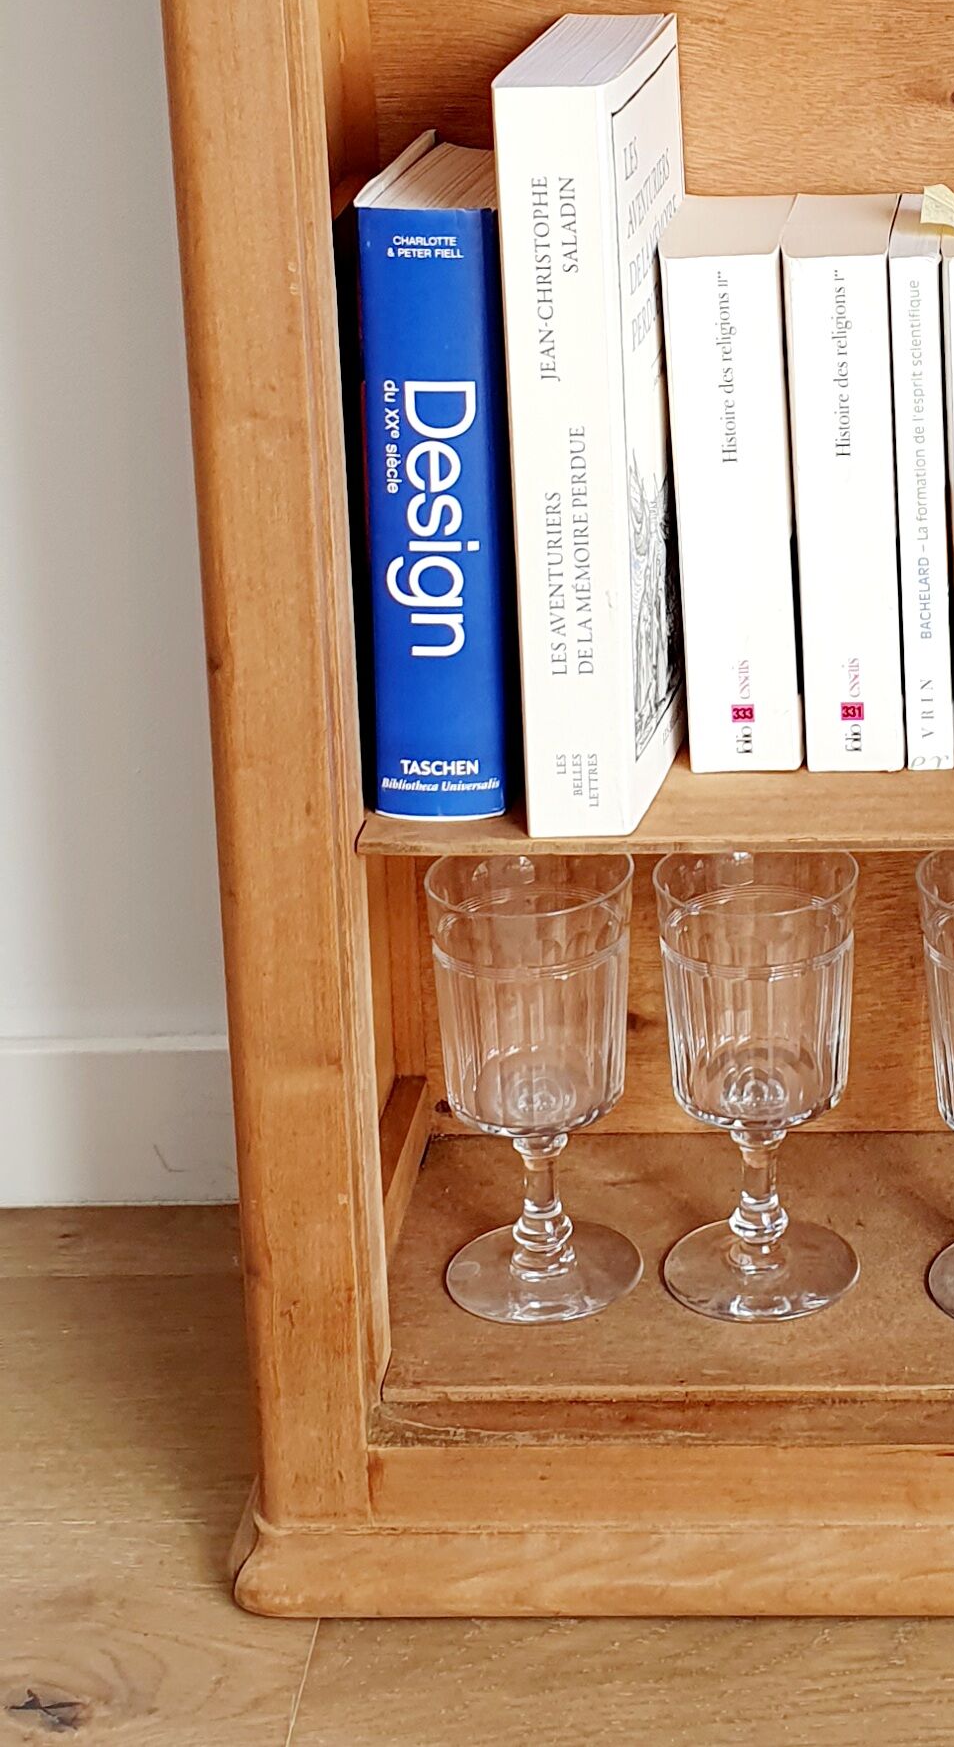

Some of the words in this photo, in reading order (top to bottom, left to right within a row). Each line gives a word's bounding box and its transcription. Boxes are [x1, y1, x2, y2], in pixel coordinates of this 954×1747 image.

[624, 136, 638, 181] LES
[392, 236, 458, 248] CHARLOTTE
[558, 176, 578, 273] SALADIN
[387, 249, 395, 258] &
[397, 248, 432, 259] PETER
[434, 248, 464, 259] FIELL
[531, 176, 560, 382] JEAN-CHRISTOPHE
[715, 292, 737, 362] religions
[831, 286, 852, 357] religions
[909, 279, 923, 367] scientifique
[383, 380, 399, 403] du
[718, 366, 734, 394] des
[833, 361, 849, 388] des
[720, 399, 737, 463] Histoire
[834, 393, 851, 457] Histoire
[913, 427, 926, 444] de
[386, 444, 402, 494] siècle
[569, 425, 588, 508] PERDUE
[914, 449, 928, 523] formation
[386, 380, 481, 657] Design
[917, 526, 928, 541] La
[545, 491, 567, 638] AVENTURIERS
[571, 512, 592, 613] MÉMOIRE
[917, 556, 932, 639] BACHELARD
[576, 616, 593, 644] LA
[551, 642, 568, 676] LES
[577, 647, 594, 675] DE
[732, 707, 753, 720] 333
[842, 706, 863, 718] 331
[920, 678, 934, 739] VRIN
[381, 777, 439, 792] Bibliotheca
[441, 776, 500, 792] Universalis
[400, 759, 479, 776] TASCHEN
[557, 753, 567, 775] LES
[572, 753, 583, 796] BELLES
[588, 753, 599, 808] LETTRES
